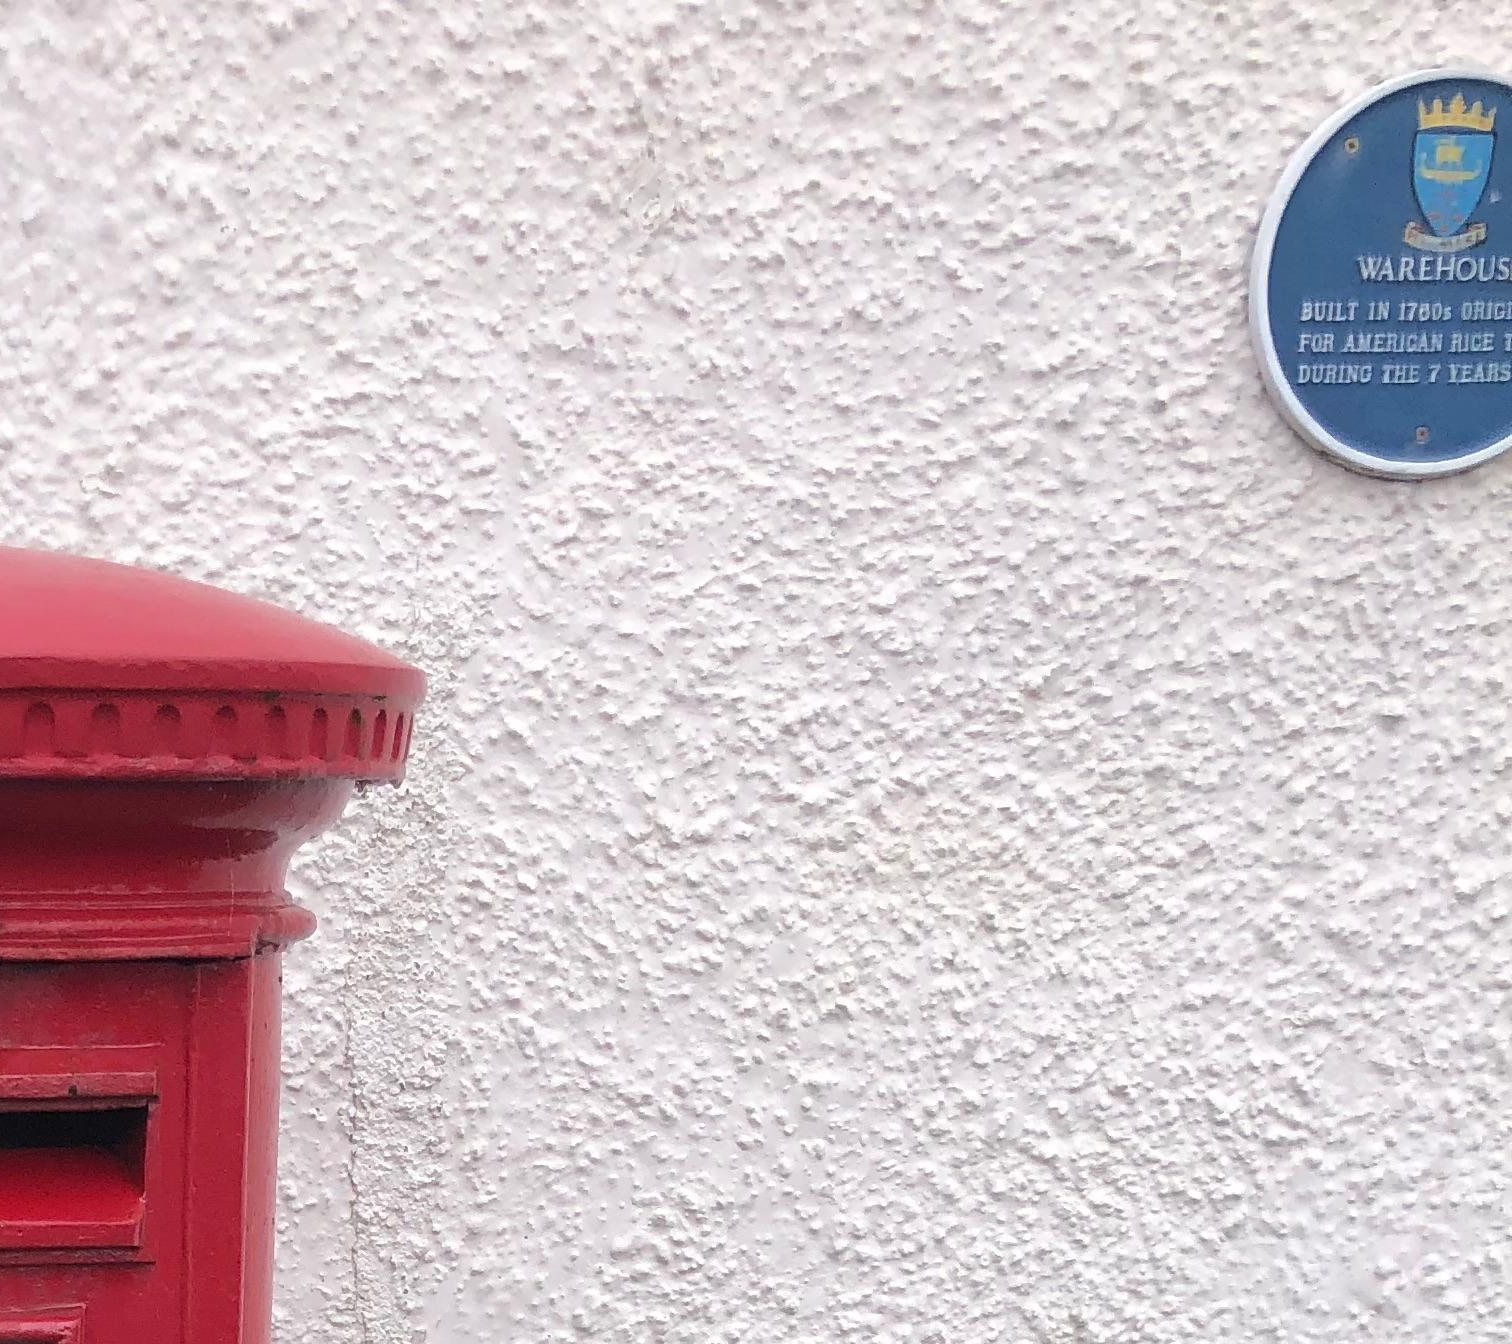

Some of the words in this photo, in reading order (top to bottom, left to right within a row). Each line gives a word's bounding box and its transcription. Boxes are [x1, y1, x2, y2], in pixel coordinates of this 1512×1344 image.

[1357, 254, 1512, 281] WAREHOUS
[1300, 301, 1359, 322] BUILT
[1367, 301, 1390, 321] IN
[1297, 332, 1335, 352] FOR
[1341, 331, 1444, 353] AMERICAN
[1447, 331, 1495, 352] RICE
[1297, 363, 1372, 384] DURING
[1381, 363, 1420, 384] THE
[1428, 364, 1441, 383] 7
[1448, 362, 1512, 384] YEARS
